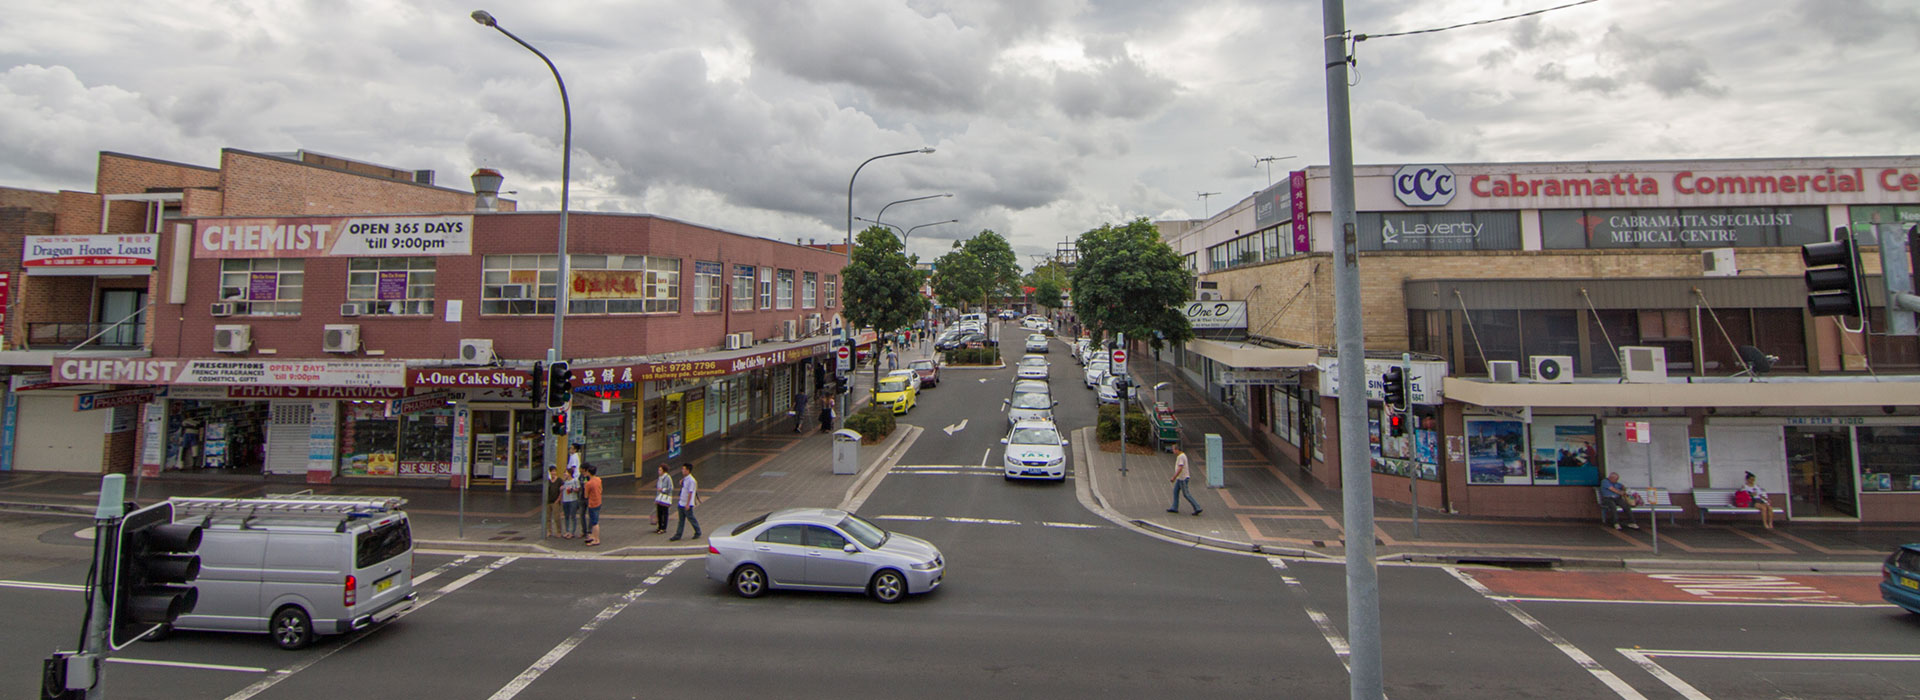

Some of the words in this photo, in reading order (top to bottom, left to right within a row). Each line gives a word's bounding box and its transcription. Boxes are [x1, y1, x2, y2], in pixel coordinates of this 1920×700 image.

[1470, 173, 1659, 198] Cabramatta
[1673, 167, 1865, 195] Commercial
[1880, 168, 1919, 192] Ce
[1609, 215, 1708, 228] CABRAMATTA
[1710, 213, 1793, 226] SPECIALIST
[349, 223, 389, 235] OPEN
[394, 223, 419, 234] 365
[424, 221, 463, 233] DAYS
[1402, 220, 1484, 238] Laverty
[202, 224, 331, 251] CHEMIST
[1611, 230, 1678, 243] MEDICAL
[1680, 229, 1738, 242] CENTRE
[33, 244, 73, 259] Dragon
[79, 244, 112, 255] Home
[118, 243, 151, 255] Loans
[365, 237, 387, 249] 'till
[391, 237, 445, 251] 9:00pm
[1214, 303, 1229, 317] D
[60, 359, 178, 382] CHEMIST
[193, 362, 265, 370] PRESCRIPTIONS
[269, 364, 293, 372] OPEN
[650, 364, 667, 374] Tel:
[669, 362, 692, 372] 9728
[694, 361, 716, 370] 7796
[288, 373, 320, 382] 9:00pm
[416, 372, 456, 385] A-One
[458, 372, 490, 385] Cake
[492, 372, 524, 388] Shop
[654, 372, 678, 380] Railway
[692, 368, 726, 377] Cabramatta
[231, 386, 299, 397] PHAMS
[402, 397, 447, 414] PHARMACY
[1786, 417, 1806, 425] THAI
[400, 463, 417, 474] SALE
[419, 463, 436, 474] SALE
[438, 463, 451, 474] SAL
